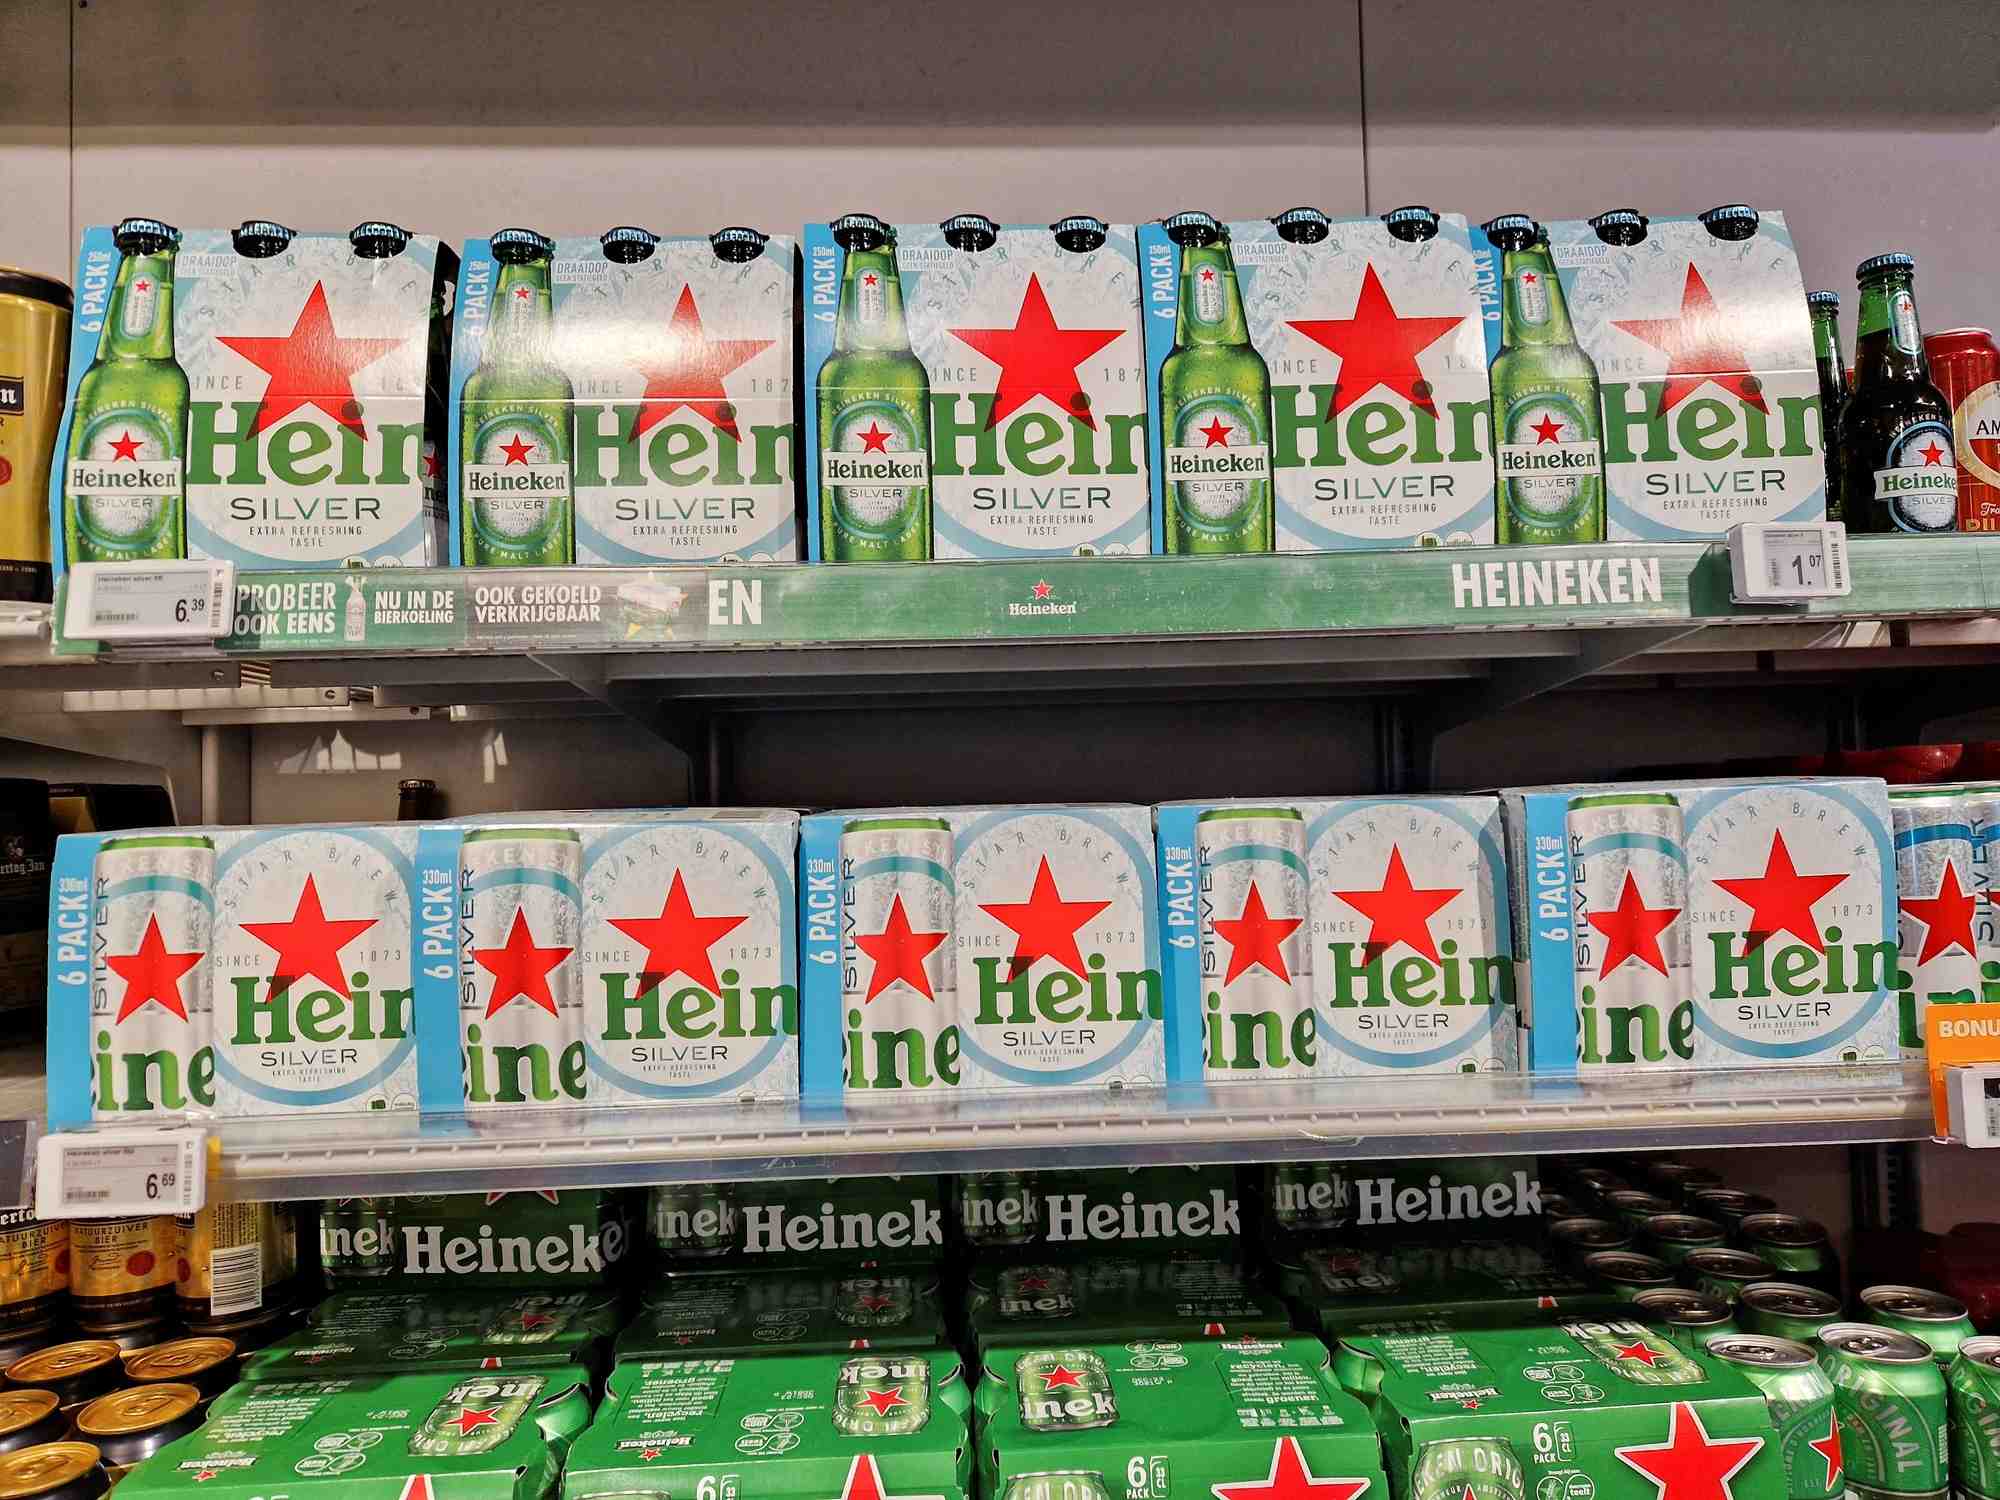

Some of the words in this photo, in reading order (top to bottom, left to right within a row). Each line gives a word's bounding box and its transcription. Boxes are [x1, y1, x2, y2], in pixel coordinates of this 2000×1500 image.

[902, 250, 953, 262] DRAAIDOP
[1237, 244, 1287, 256] DRAAIDOP
[1557, 246, 1608, 258] DRAAIDOP
[557, 262, 608, 273] DRAAIDOP
[82, 263, 110, 315] PACK
[812, 257, 836, 305] PACK
[1150, 256, 1177, 302] PACK
[1472, 259, 1500, 306] PACK
[464, 271, 490, 322] PACK
[813, 311, 836, 322] 6
[1153, 308, 1177, 319] 6
[80, 320, 102, 333] 6
[1271, 380, 1493, 468] Hein
[1600, 376, 1825, 464] Hein
[187, 401, 424, 486] Hein
[574, 401, 794, 488] Hein
[928, 392, 1148, 477] Hein
[1170, 453, 1264, 473] Heineken
[1502, 449, 1596, 470] Heineken
[72, 468, 176, 488] Heineken
[827, 460, 923, 480] Heineken
[468, 471, 566, 491] Heineken
[1192, 482, 1245, 493] SILVER
[1314, 475, 1455, 501] SILVER
[1523, 477, 1576, 489] SILVER
[1646, 469, 1786, 496] SILVER
[1882, 472, 1957, 494] Heineke
[94, 498, 153, 509] SILVER
[849, 488, 903, 499] SILVER
[973, 487, 1111, 510] SILVER
[1663, 500, 1696, 510] EXTRA
[1702, 497, 1767, 509] REFRESHING
[231, 496, 381, 521] SILVER
[490, 500, 544, 511] SILVER
[615, 498, 755, 521] SILVER
[1331, 505, 1364, 516] EXTRA
[1371, 503, 1437, 514] REFRESHING
[1699, 509, 1731, 520] TASTE
[990, 515, 1022, 525] EXTRA
[1029, 514, 1094, 525] REFRESHING
[1369, 515, 1400, 526] TASTE
[250, 526, 285, 536] EXTRA
[292, 525, 362, 536] REFRESHING
[633, 525, 666, 536] EXTRA
[672, 525, 738, 535] REFRESHING
[1027, 526, 1057, 536] TASTE
[290, 537, 324, 548] TASTE
[670, 536, 702, 546] TASTE
[1792, 554, 1822, 586] 1.07
[1451, 557, 1664, 609] HEINEKEN
[236, 583, 336, 612] PROBEER
[375, 591, 401, 609] NU
[406, 591, 426, 609] IN
[432, 590, 455, 608] DE
[474, 585, 517, 606] OOK
[521, 584, 600, 606] GEKOELD
[708, 579, 762, 625] EN
[175, 598, 205, 623] 6.39
[373, 610, 455, 625] BIERKOELING
[474, 605, 600, 625] VERKRIJGBAAR
[1008, 602, 1077, 616] Heineken
[234, 611, 279, 636] OOK
[287, 611, 336, 635] EENS
[1165, 846, 1193, 860] 330ml
[1535, 836, 1563, 851] 330ml
[807, 858, 835, 873] 330ml
[422, 869, 452, 885] 330ml
[1536, 851, 1568, 918] PACK
[1166, 861, 1195, 926] PACK
[1572, 834, 1591, 966] SILVER
[807, 874, 836, 941] PACK
[1201, 845, 1217, 972] SILVER
[1692, 910, 1736, 923] SINCE
[1831, 903, 1873, 918] 1873
[57, 893, 88, 962] PACK
[422, 885, 453, 956] PACK
[843, 857, 857, 988] SILVER
[1313, 921, 1356, 934] SINCE
[1447, 918, 1488, 931] 1873
[94, 877, 111, 1010] SILVER
[461, 868, 476, 1005] SILVER
[958, 935, 1001, 948] SINCE
[1095, 931, 1136, 944] 1873
[1168, 934, 1195, 949] 6
[1540, 927, 1569, 941] 6
[216, 954, 261, 968] SINCE
[359, 949, 402, 963] 1873
[584, 950, 631, 963] SINCE
[729, 947, 773, 961] 1873
[809, 950, 837, 964] 6
[1708, 925, 1902, 1000] Hein
[57, 971, 87, 985] 6
[423, 964, 454, 979] 6
[1327, 938, 1516, 1009] Hein
[972, 952, 1163, 1025] Hein
[230, 971, 416, 1045] Hein
[600, 968, 798, 1040] Hein
[1737, 1001, 1832, 1021] SILVER
[1357, 1013, 1450, 1030] SILVER
[1938, 1019, 2000, 1038] BONU
[1002, 1029, 1096, 1046] SILVER
[261, 1048, 358, 1067] SILVER
[631, 1045, 729, 1062] SILVER
[1355, 1170, 1543, 1225] Heinek
[1045, 1189, 1240, 1241] Heinek
[743, 1200, 943, 1252] Heinek
[1532, 1423, 1553, 1452] 6
[1533, 1452, 1556, 1464] PACK
[1127, 1456, 1147, 1488] 6
[697, 1476, 717, 1500] 6
[1126, 1487, 1149, 1499] PACK
